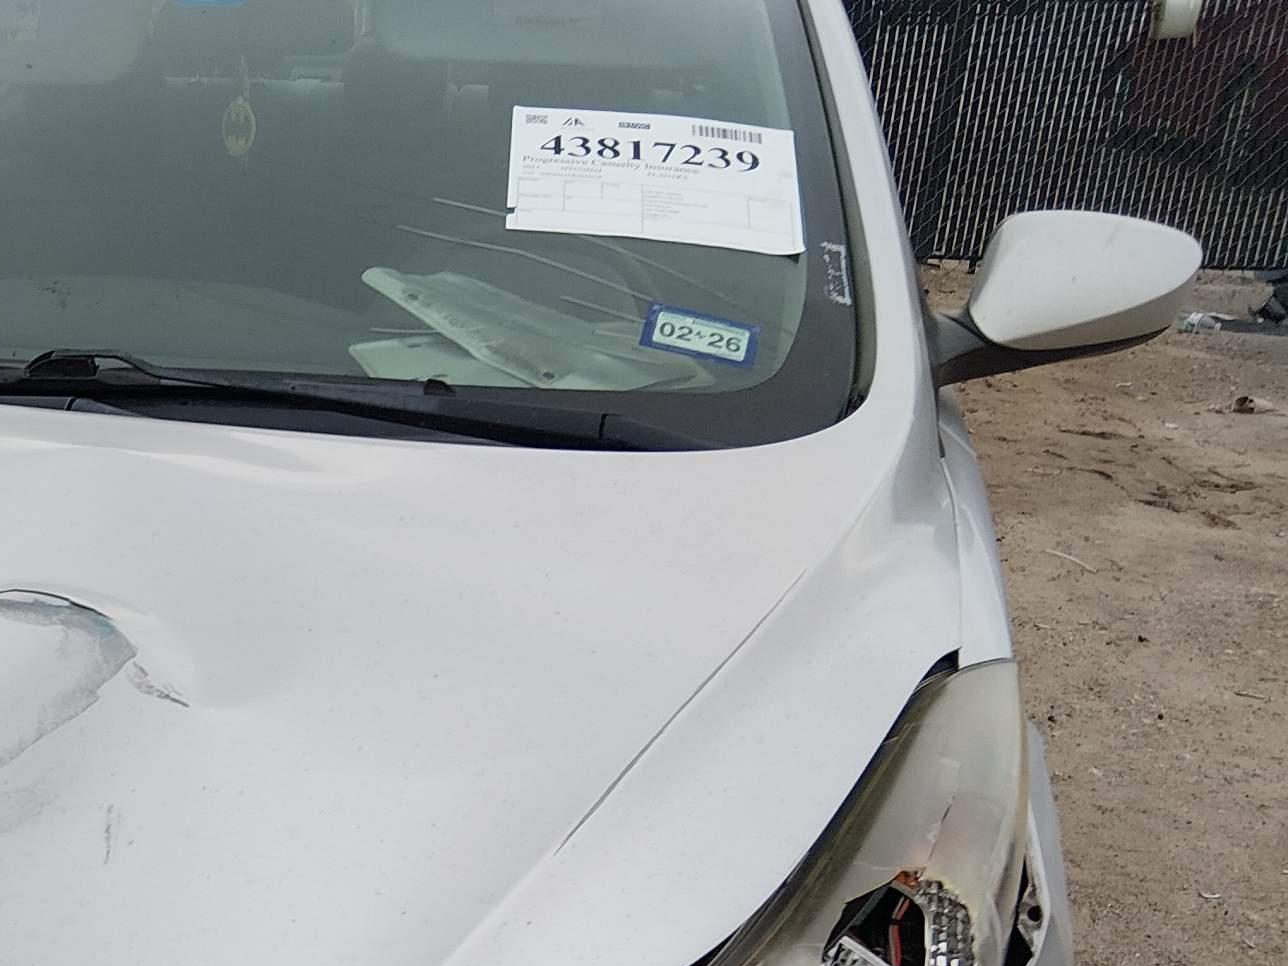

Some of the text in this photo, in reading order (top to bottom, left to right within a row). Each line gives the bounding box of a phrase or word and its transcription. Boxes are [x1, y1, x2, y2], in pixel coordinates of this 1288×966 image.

[522, 155, 588, 167] Progressive
[591, 159, 641, 170] Casualty
[644, 162, 700, 174] Insurance
[541, 135, 760, 172] 43817239
[660, 322, 741, 352] 02 26
